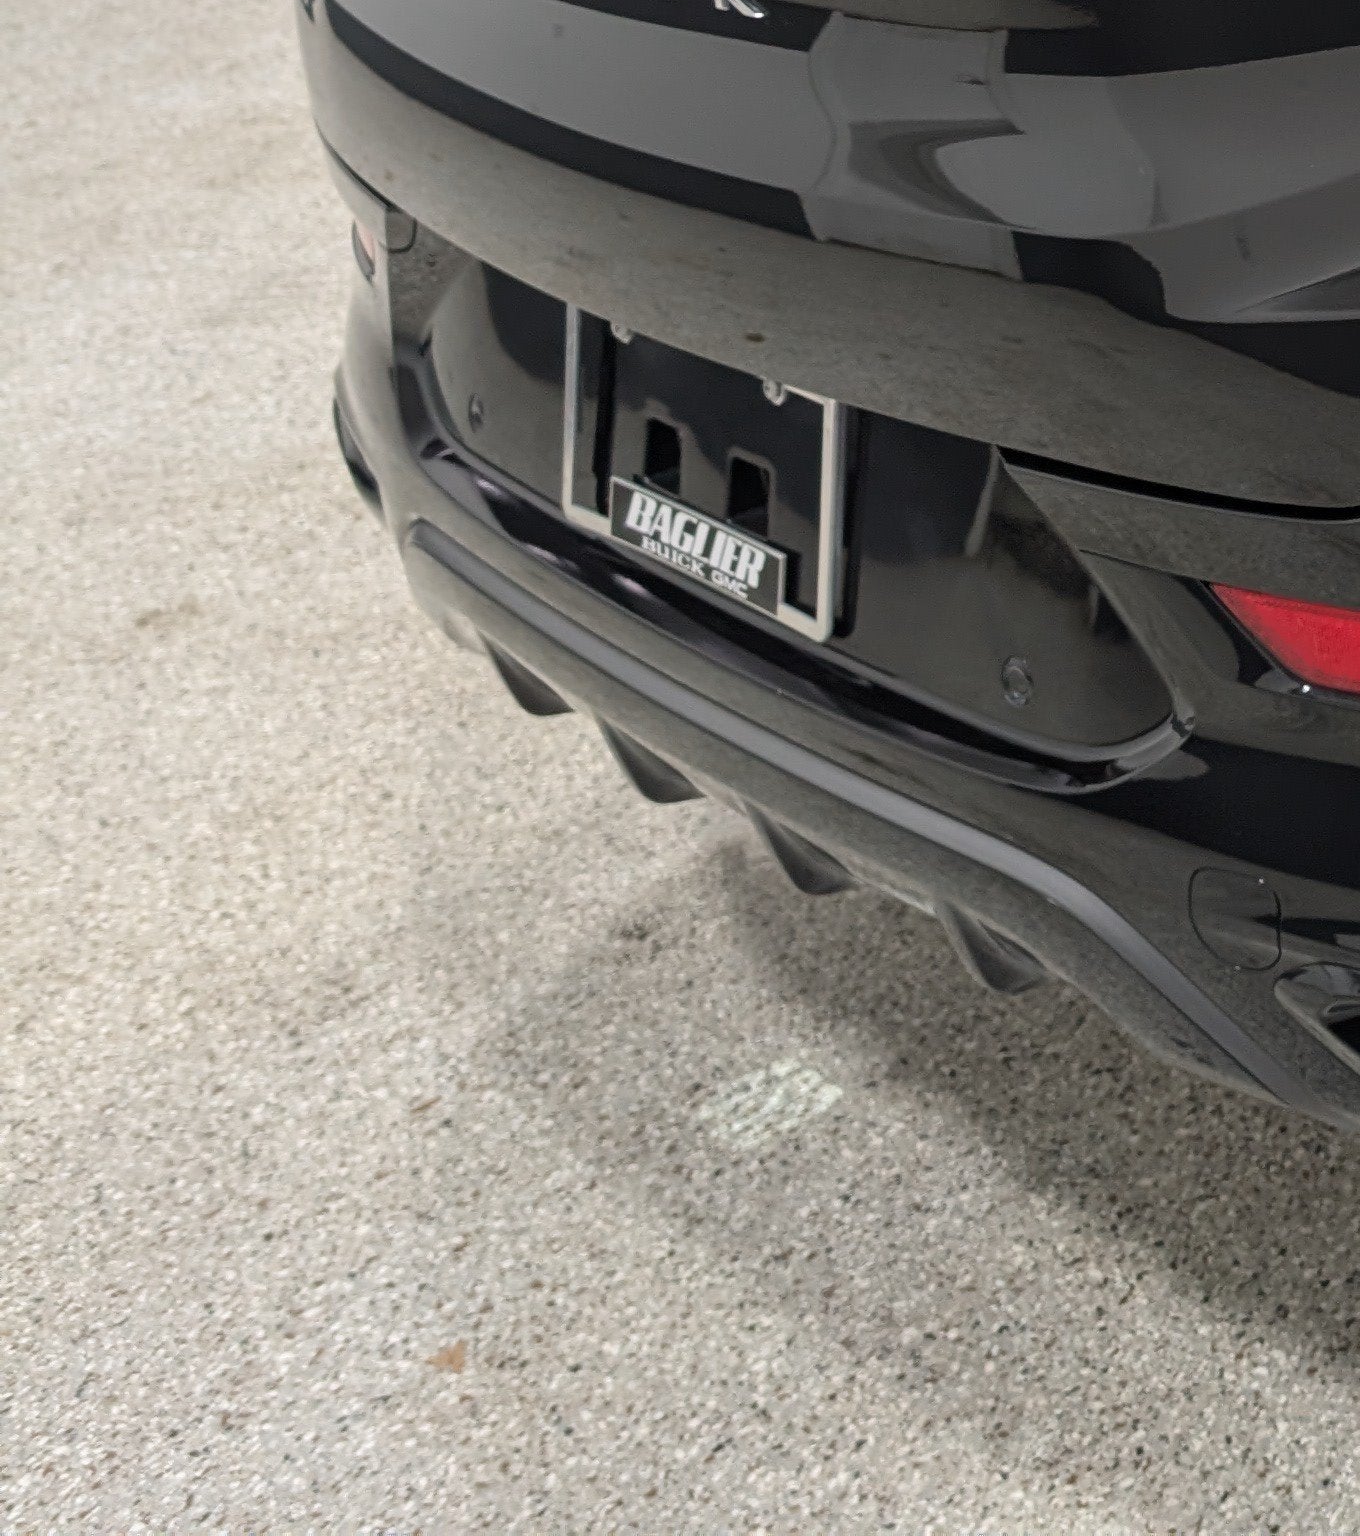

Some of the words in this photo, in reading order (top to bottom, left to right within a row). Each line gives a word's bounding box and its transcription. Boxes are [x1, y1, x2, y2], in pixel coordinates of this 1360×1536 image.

[625, 491, 766, 590] BAGLIER
[641, 535, 706, 579] BUICK
[710, 568, 749, 601] GMC
